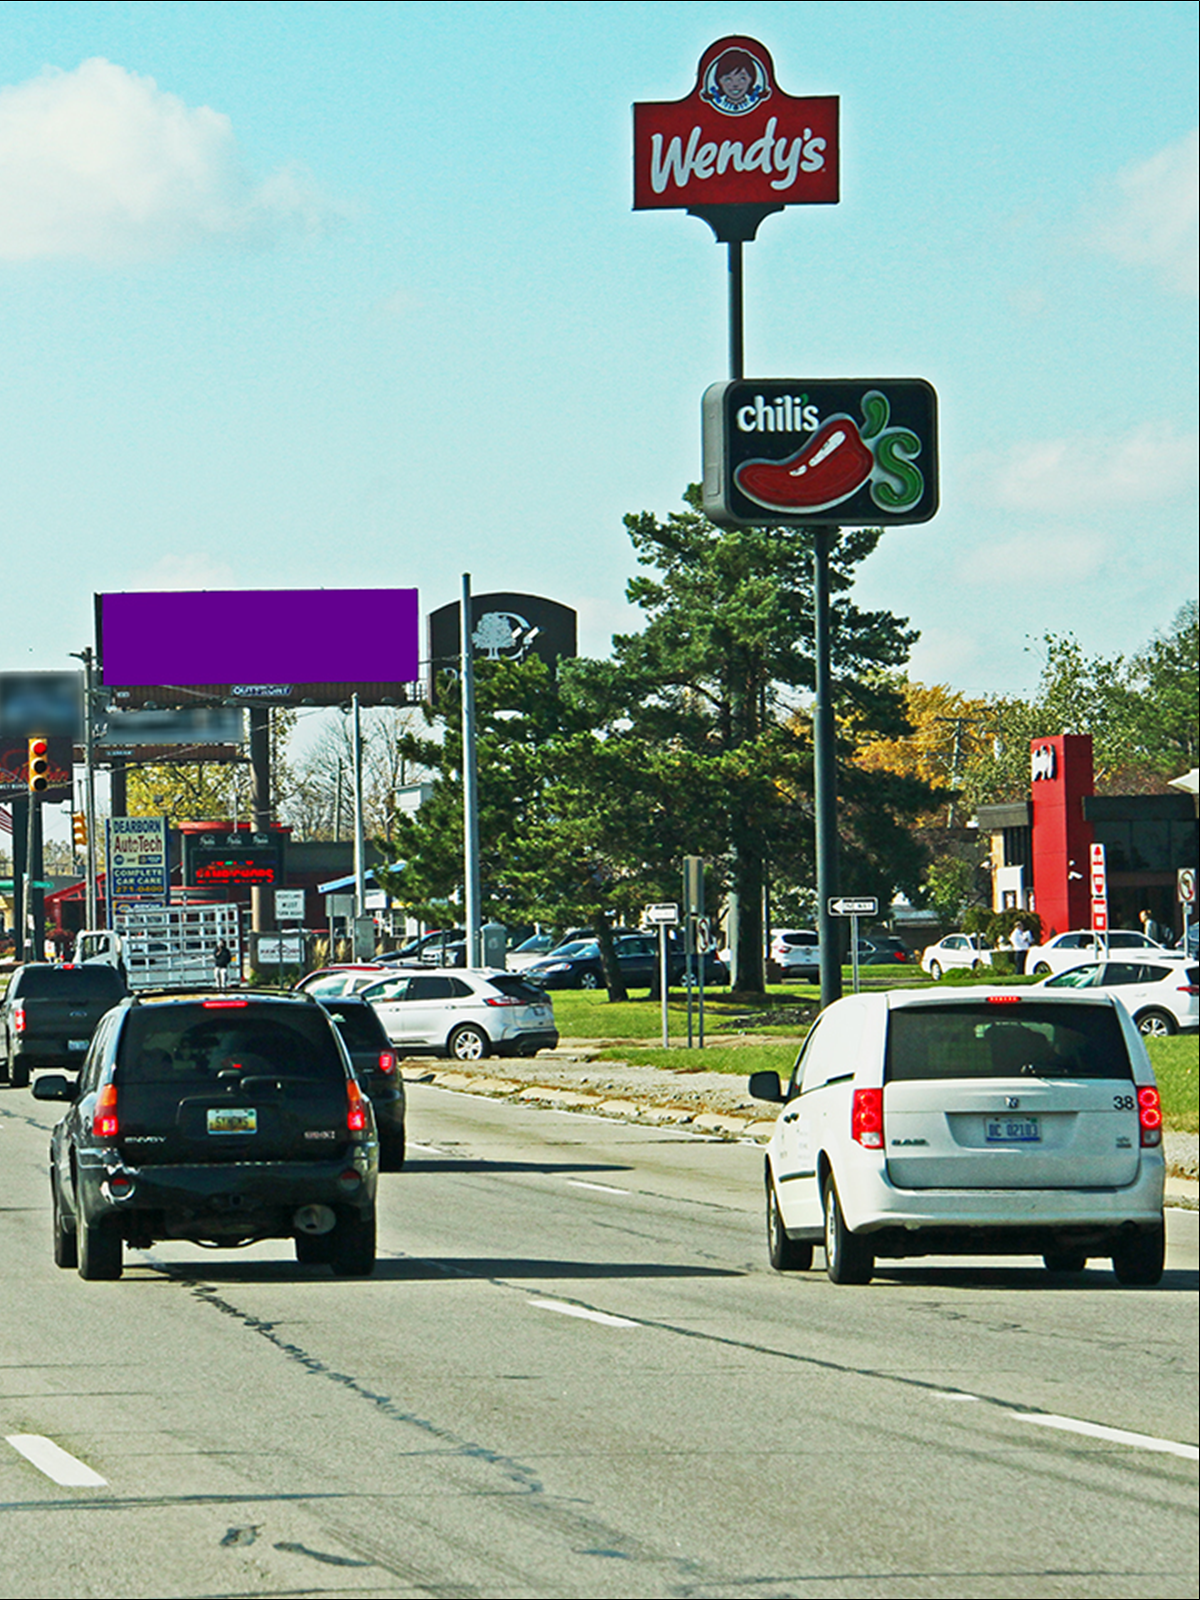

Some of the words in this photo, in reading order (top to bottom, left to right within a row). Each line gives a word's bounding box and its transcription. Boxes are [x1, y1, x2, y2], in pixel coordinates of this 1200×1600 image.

[651, 116, 827, 194] Wendy's
[736, 393, 821, 432] chili's
[113, 820, 162, 834] DEARBORN
[113, 835, 163, 852] AutoTech
[114, 869, 163, 877] COMPLETE
[1113, 1096, 1135, 1110] 38
